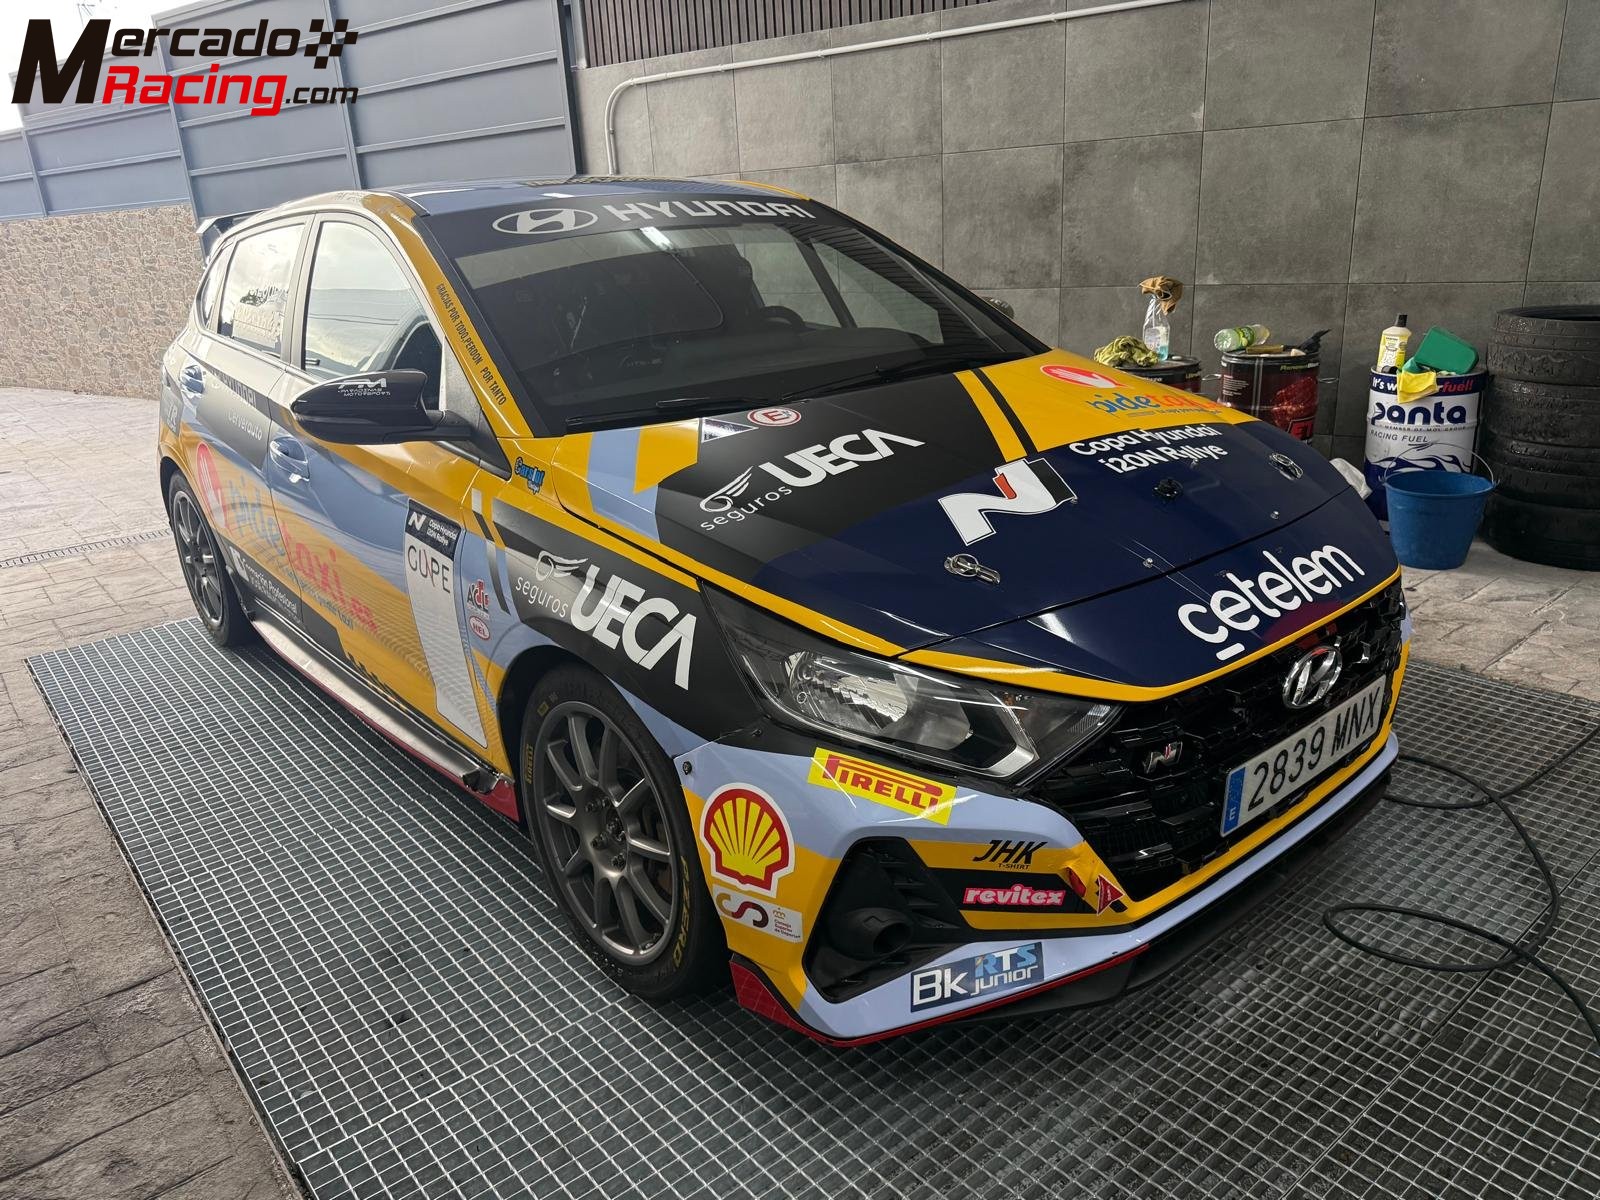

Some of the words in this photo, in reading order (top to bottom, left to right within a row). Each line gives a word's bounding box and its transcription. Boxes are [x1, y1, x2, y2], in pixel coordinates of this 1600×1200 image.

[603, 200, 816, 221] HYUNDAI
[480, 366, 494, 385] POR
[488, 382, 508, 407] TANTO
[1370, 401, 1467, 426] panta
[1069, 432, 1138, 456] Copa
[1134, 424, 1223, 445] Hyundai
[1370, 429, 1398, 441] RACING
[758, 429, 926, 487] UECA
[700, 485, 793, 531] seguros
[515, 576, 569, 618] seguros
[570, 564, 697, 691] UECA
[1247, 727, 1326, 812] 2839
[1331, 687, 1381, 756] MNX
[822, 754, 943, 813] PIRELLI
[1228, 806, 1236, 821] E
[972, 840, 1048, 865] JHK
[966, 885, 1063, 905] revitex
[975, 943, 1038, 978] RTS
